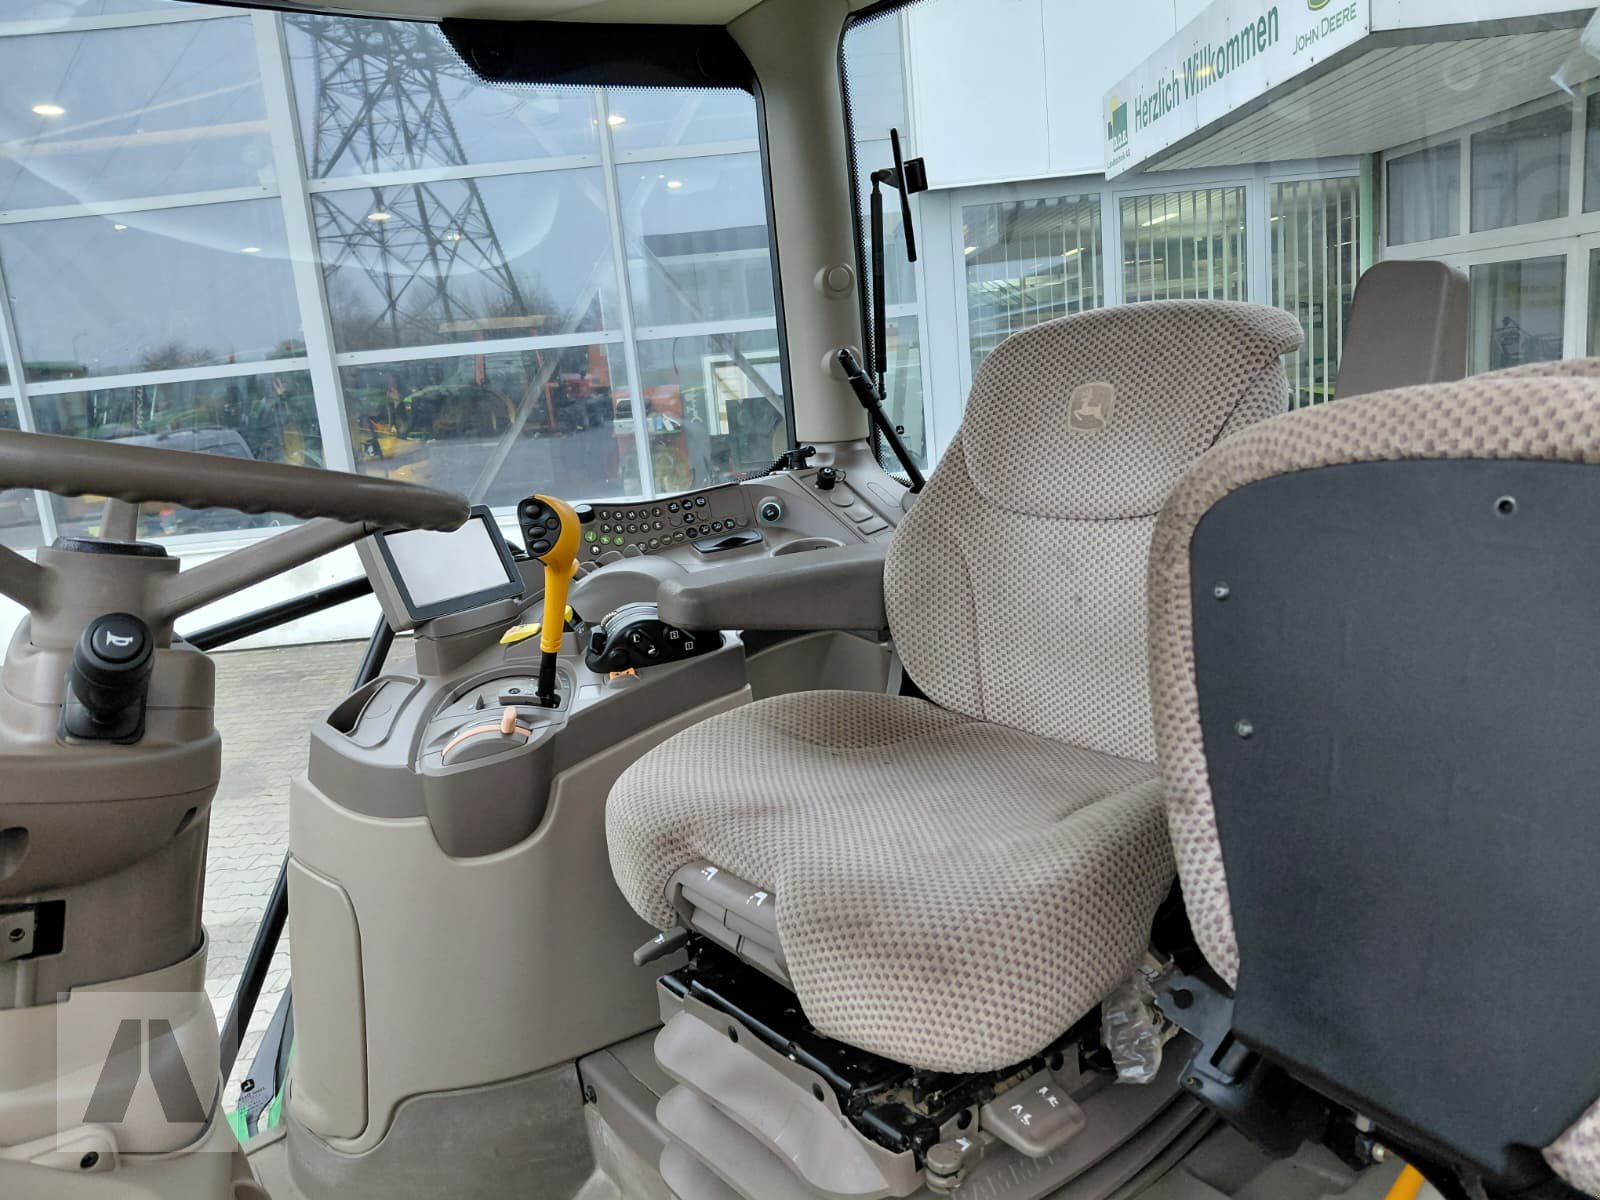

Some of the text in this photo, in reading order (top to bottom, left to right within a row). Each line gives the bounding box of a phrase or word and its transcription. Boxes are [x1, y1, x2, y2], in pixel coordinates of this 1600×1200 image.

[1134, 6, 1279, 133] Herzlich Willkommen
[1292, 2, 1357, 55] JOHN DEERE
